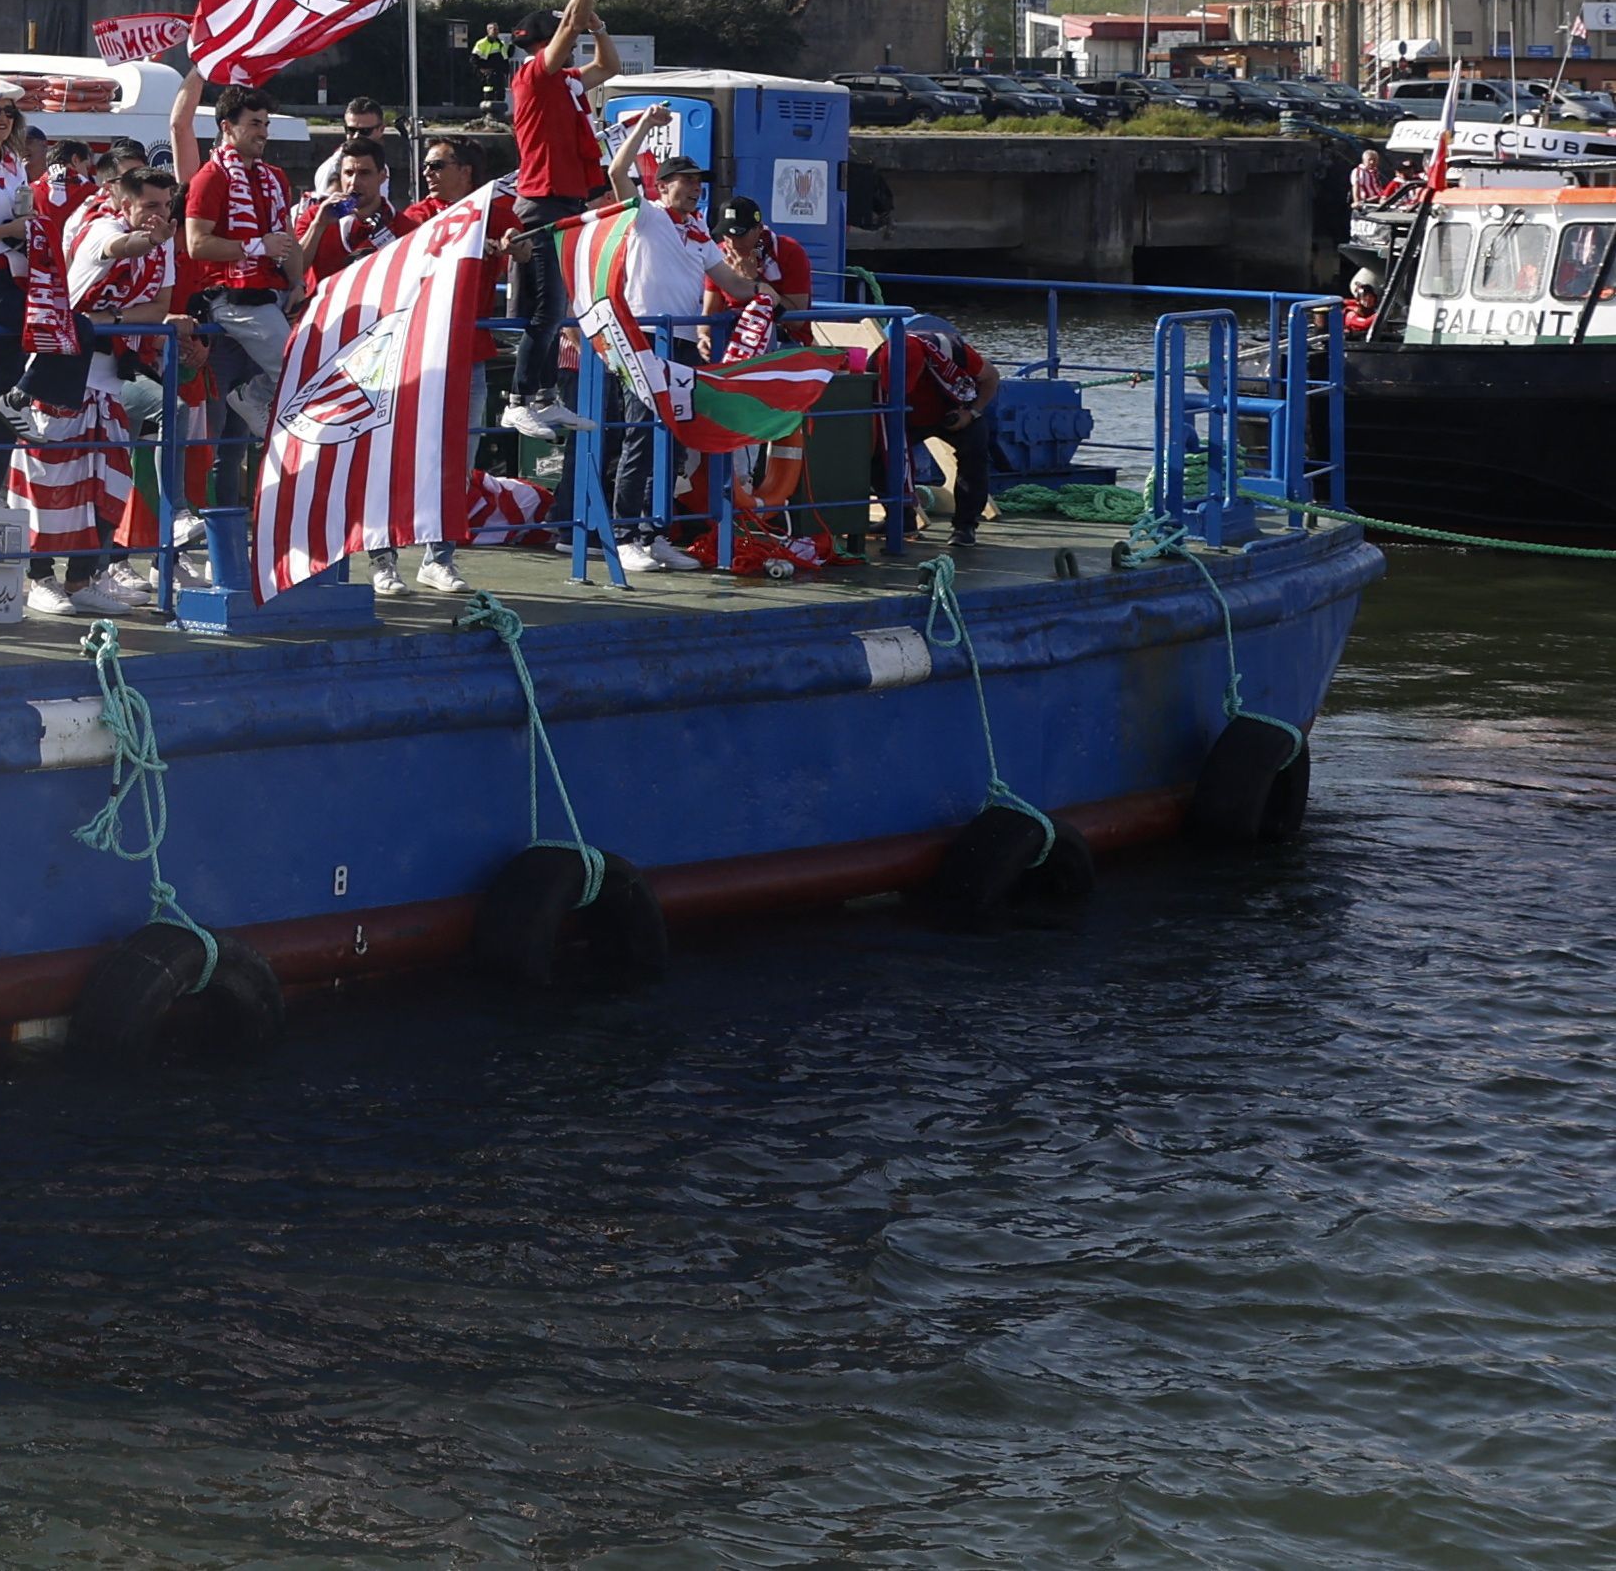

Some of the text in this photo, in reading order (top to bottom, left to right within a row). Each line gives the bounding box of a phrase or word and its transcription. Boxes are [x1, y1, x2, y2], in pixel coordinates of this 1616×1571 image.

[1498, 130, 1580, 155] CLUB
[1433, 307, 1586, 337] BALLONT
[334, 865, 348, 896] 8
